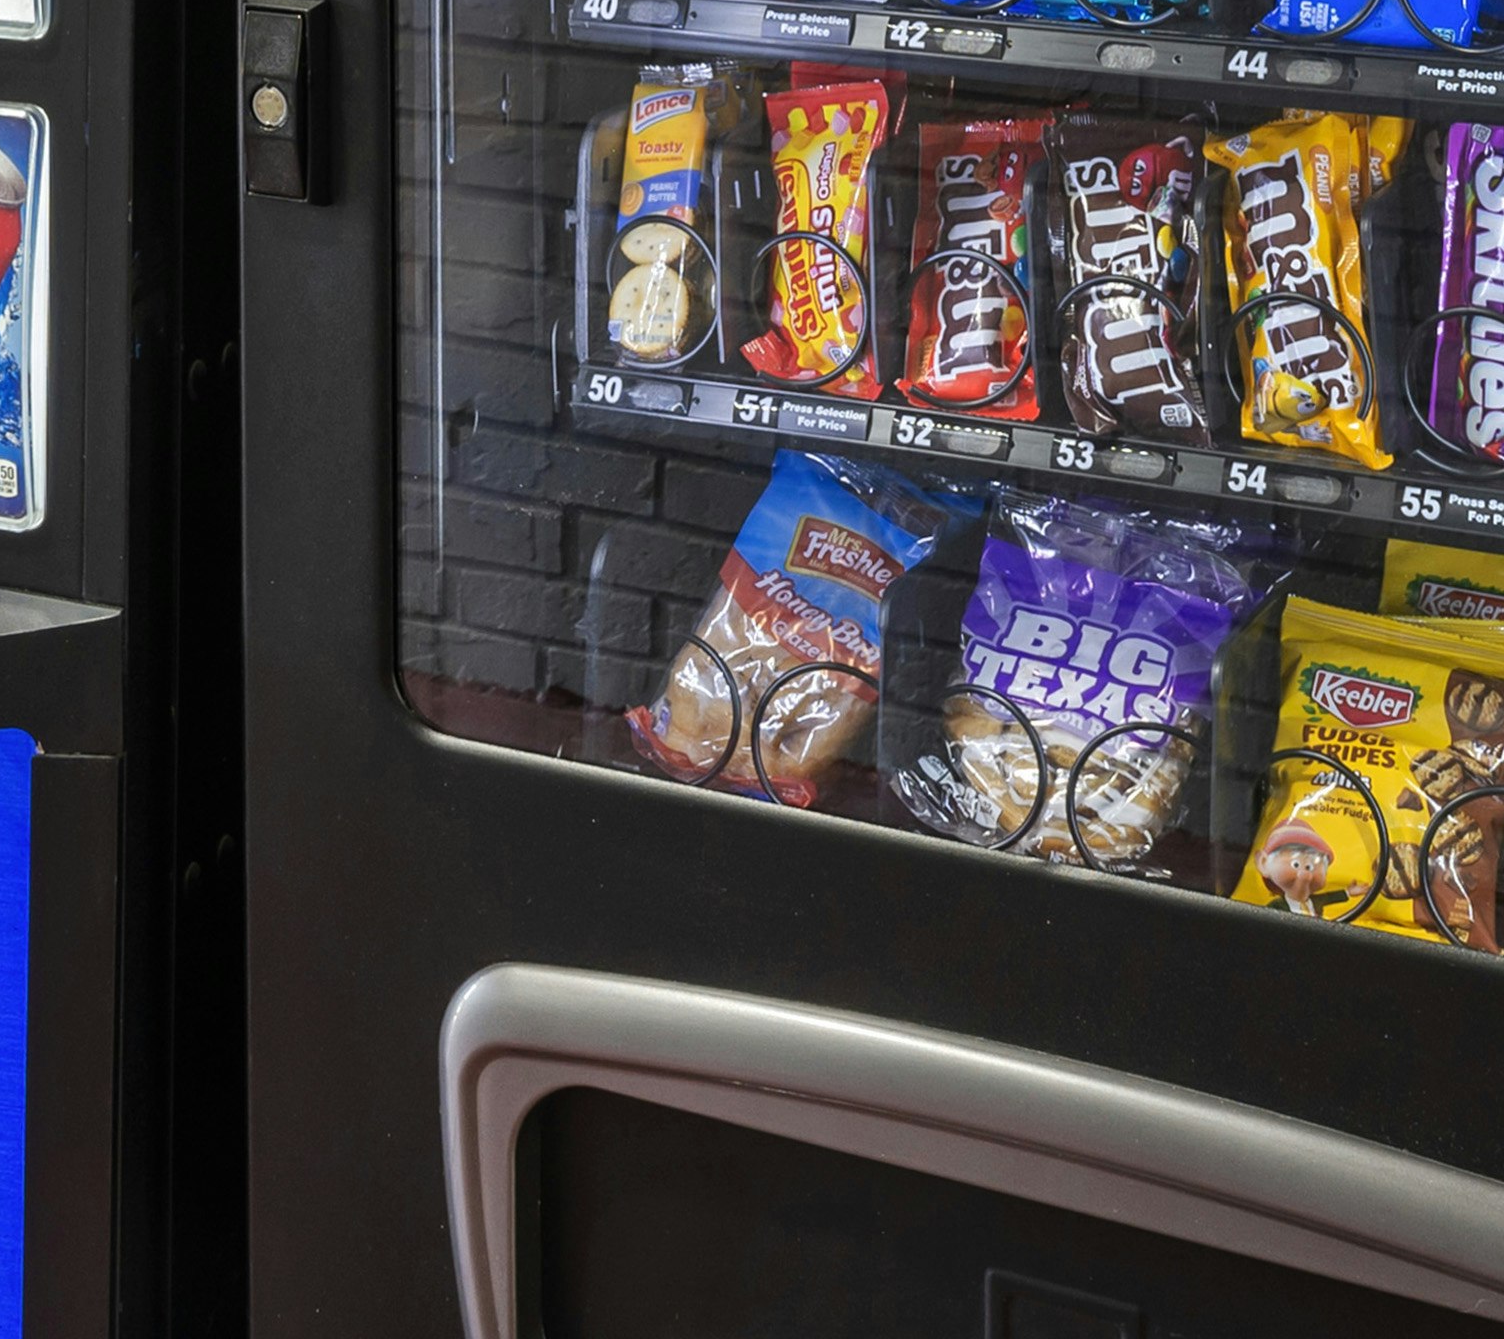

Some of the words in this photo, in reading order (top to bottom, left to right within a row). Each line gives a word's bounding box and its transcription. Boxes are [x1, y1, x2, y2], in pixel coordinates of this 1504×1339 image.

[890, 23, 927, 48] 42
[1228, 51, 1268, 78] 44
[1418, 65, 1455, 79] Press
[1436, 79, 1464, 92] For
[1467, 81, 1497, 95] Price
[635, 92, 691, 121] Lance
[1314, 153, 1332, 205] PEANUT
[588, 375, 622, 404] 50
[739, 396, 773, 424] 51
[797, 416, 819, 430] For
[821, 418, 848, 433] Price
[897, 417, 932, 447] 52
[1056, 441, 1095, 470] 53
[1228, 463, 1267, 495] 54
[1401, 488, 1442, 520] 55
[1449, 495, 1484, 511] Press
[1468, 511, 1494, 525] For
[755, 572, 832, 632] Honey
[831, 621, 881, 664] Bun
[1002, 608, 1170, 687] BIG
[969, 644, 1170, 739] TEXAS
[1315, 672, 1408, 726] Keebler
[1302, 724, 1395, 747] FUDGE
